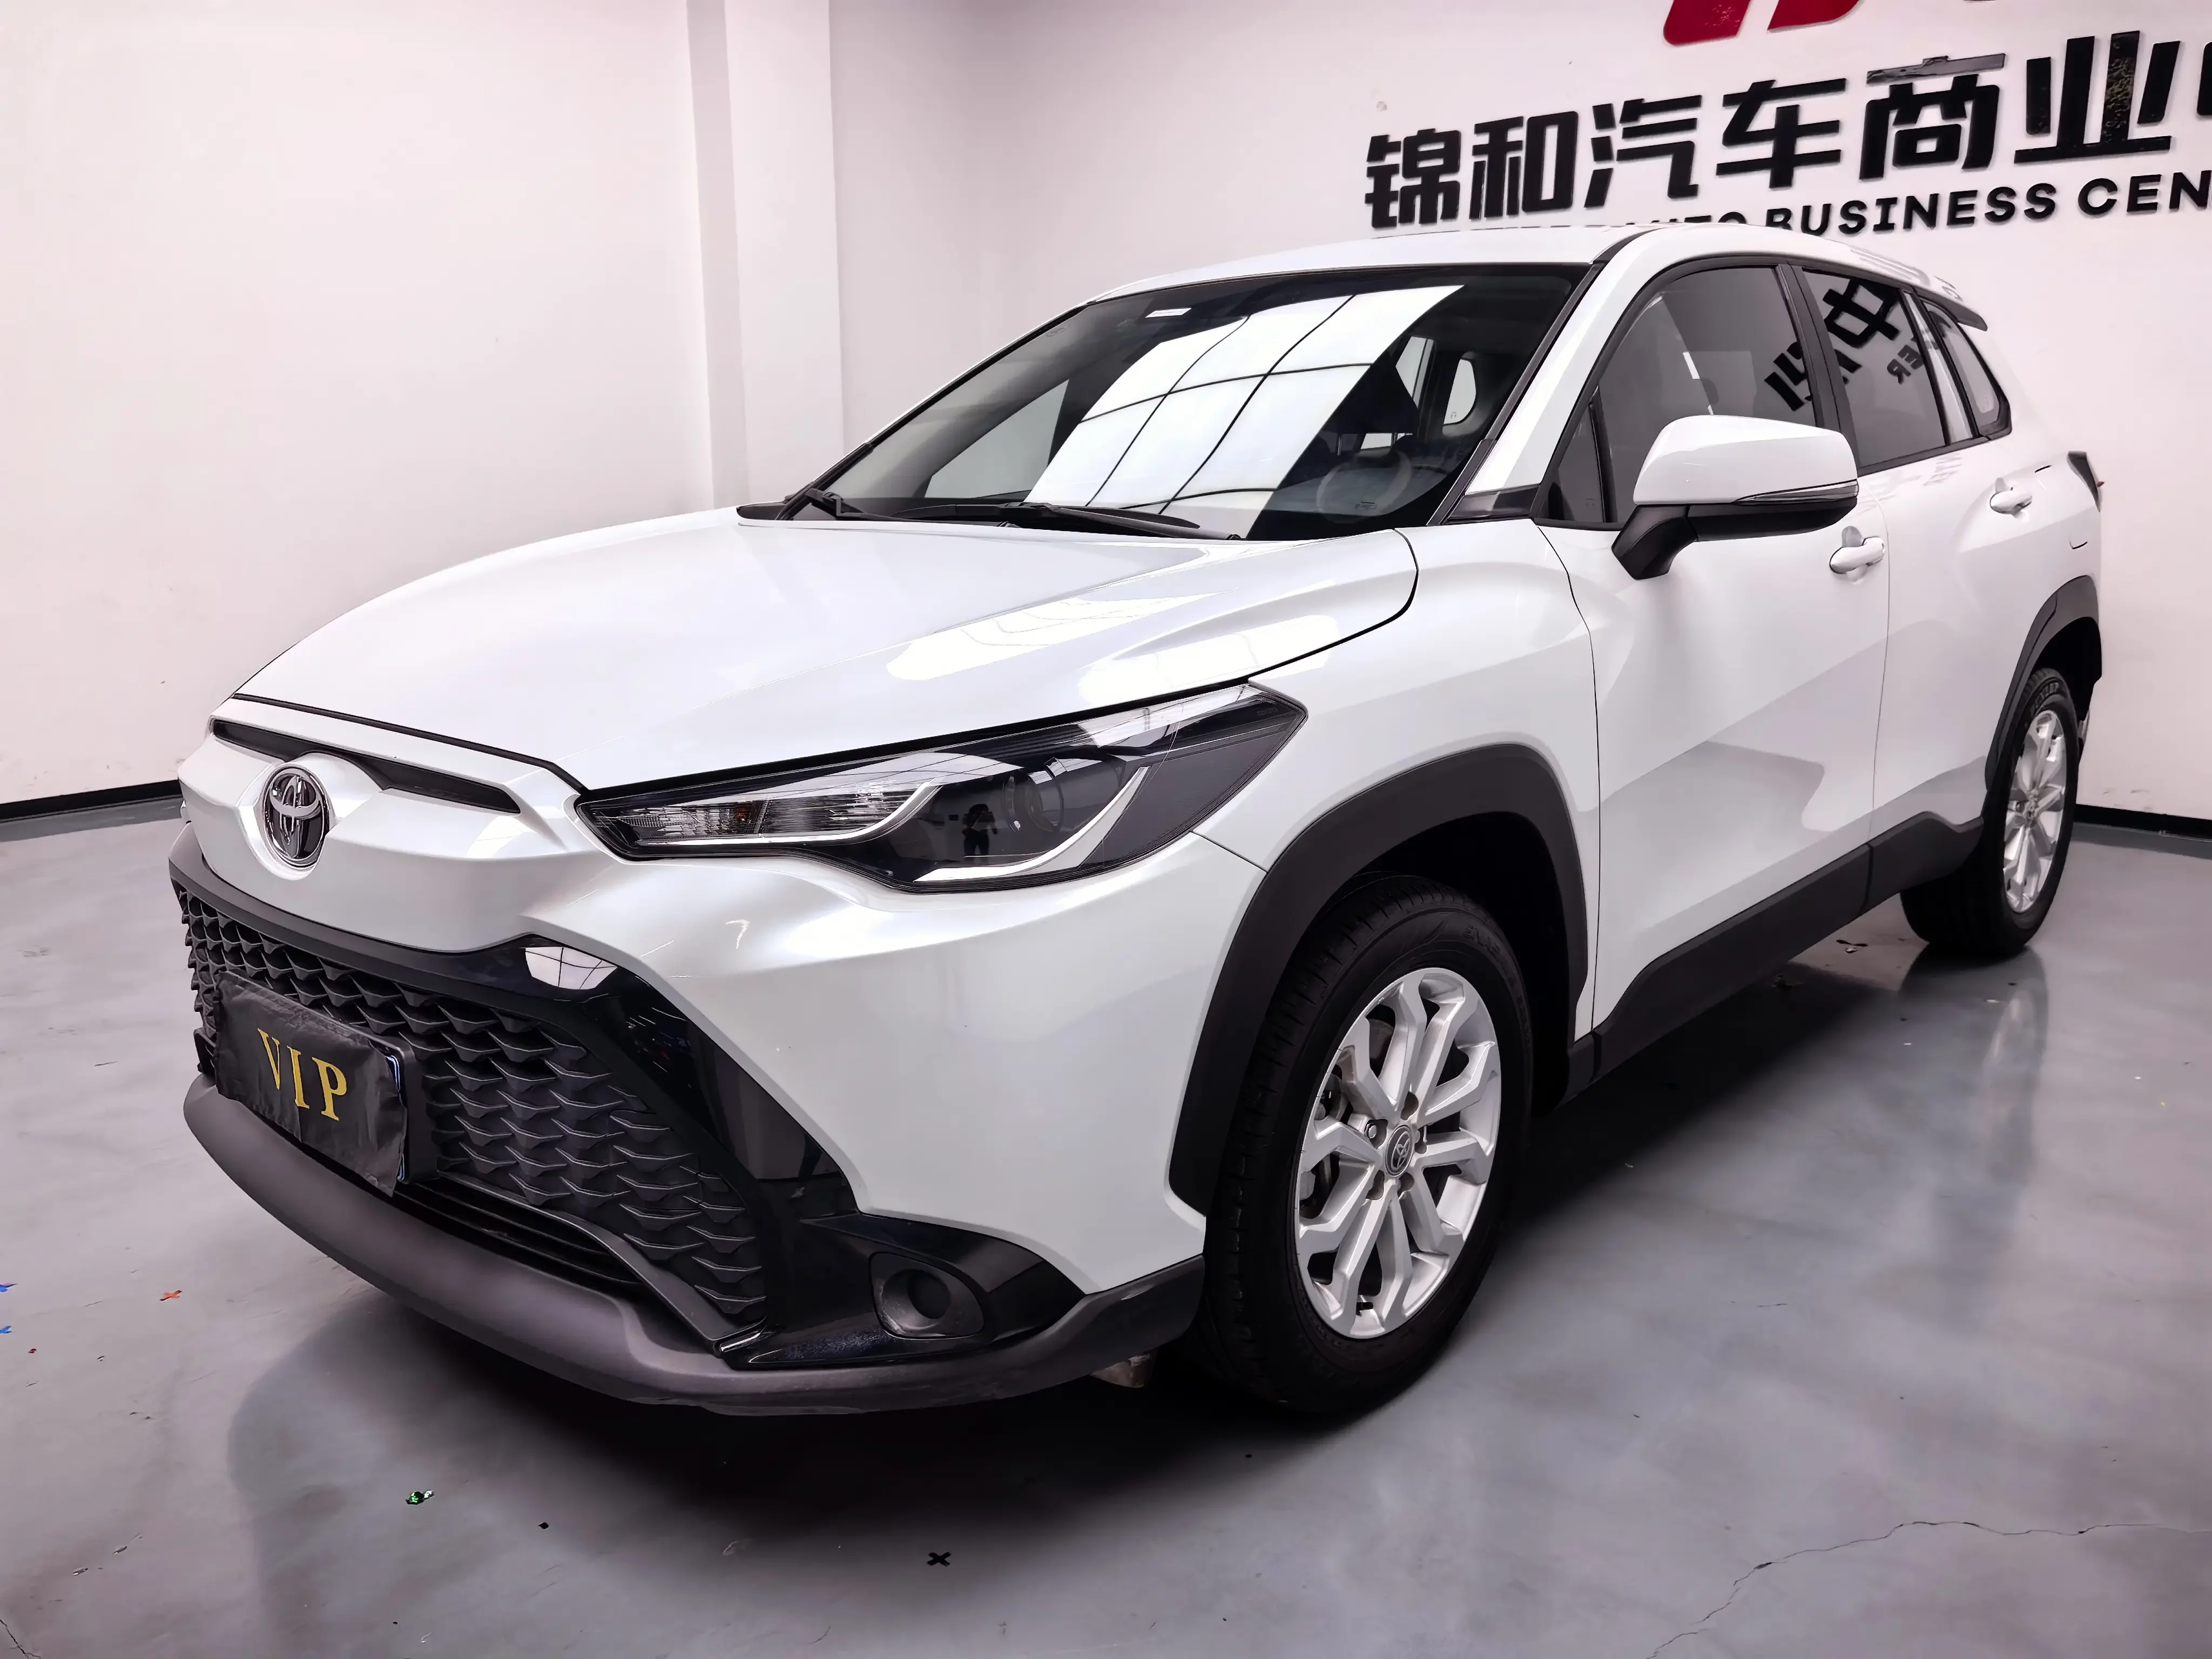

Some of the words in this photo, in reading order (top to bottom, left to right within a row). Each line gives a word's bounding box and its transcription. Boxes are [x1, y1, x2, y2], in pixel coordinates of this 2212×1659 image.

[1364, 30, 2212, 228] 锦和汽车商业
[1765, 182, 2056, 236] BUSINESS
[2078, 170, 2212, 216] CEN
[257, 1028, 347, 1121] VIP
